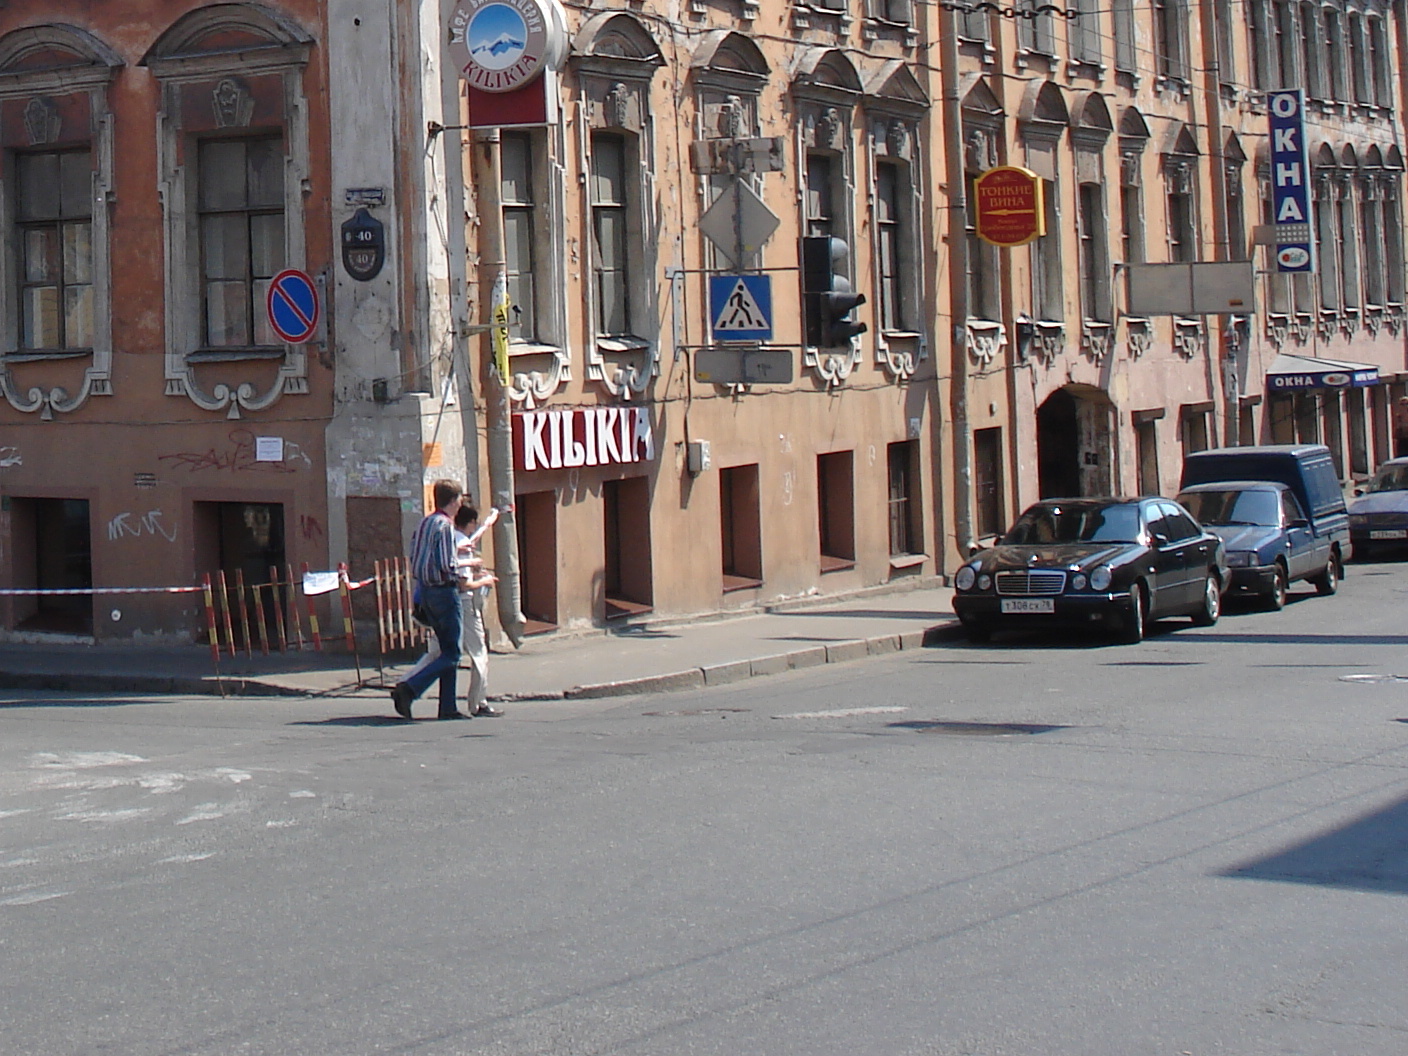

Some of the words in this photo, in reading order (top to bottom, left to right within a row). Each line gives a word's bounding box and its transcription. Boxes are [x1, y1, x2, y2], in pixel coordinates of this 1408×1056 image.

[452, 9, 469, 43] КАФЕ
[463, 54, 537, 88] KILIKIA
[1271, 93, 1303, 222] ОКНА
[980, 185, 1032, 196] ТОНКИЕ
[990, 197, 1024, 207] ВИНА
[357, 231, 372, 241] 40
[1275, 376, 1313, 387] ОКНА
[523, 407, 655, 471] KILIKIA
